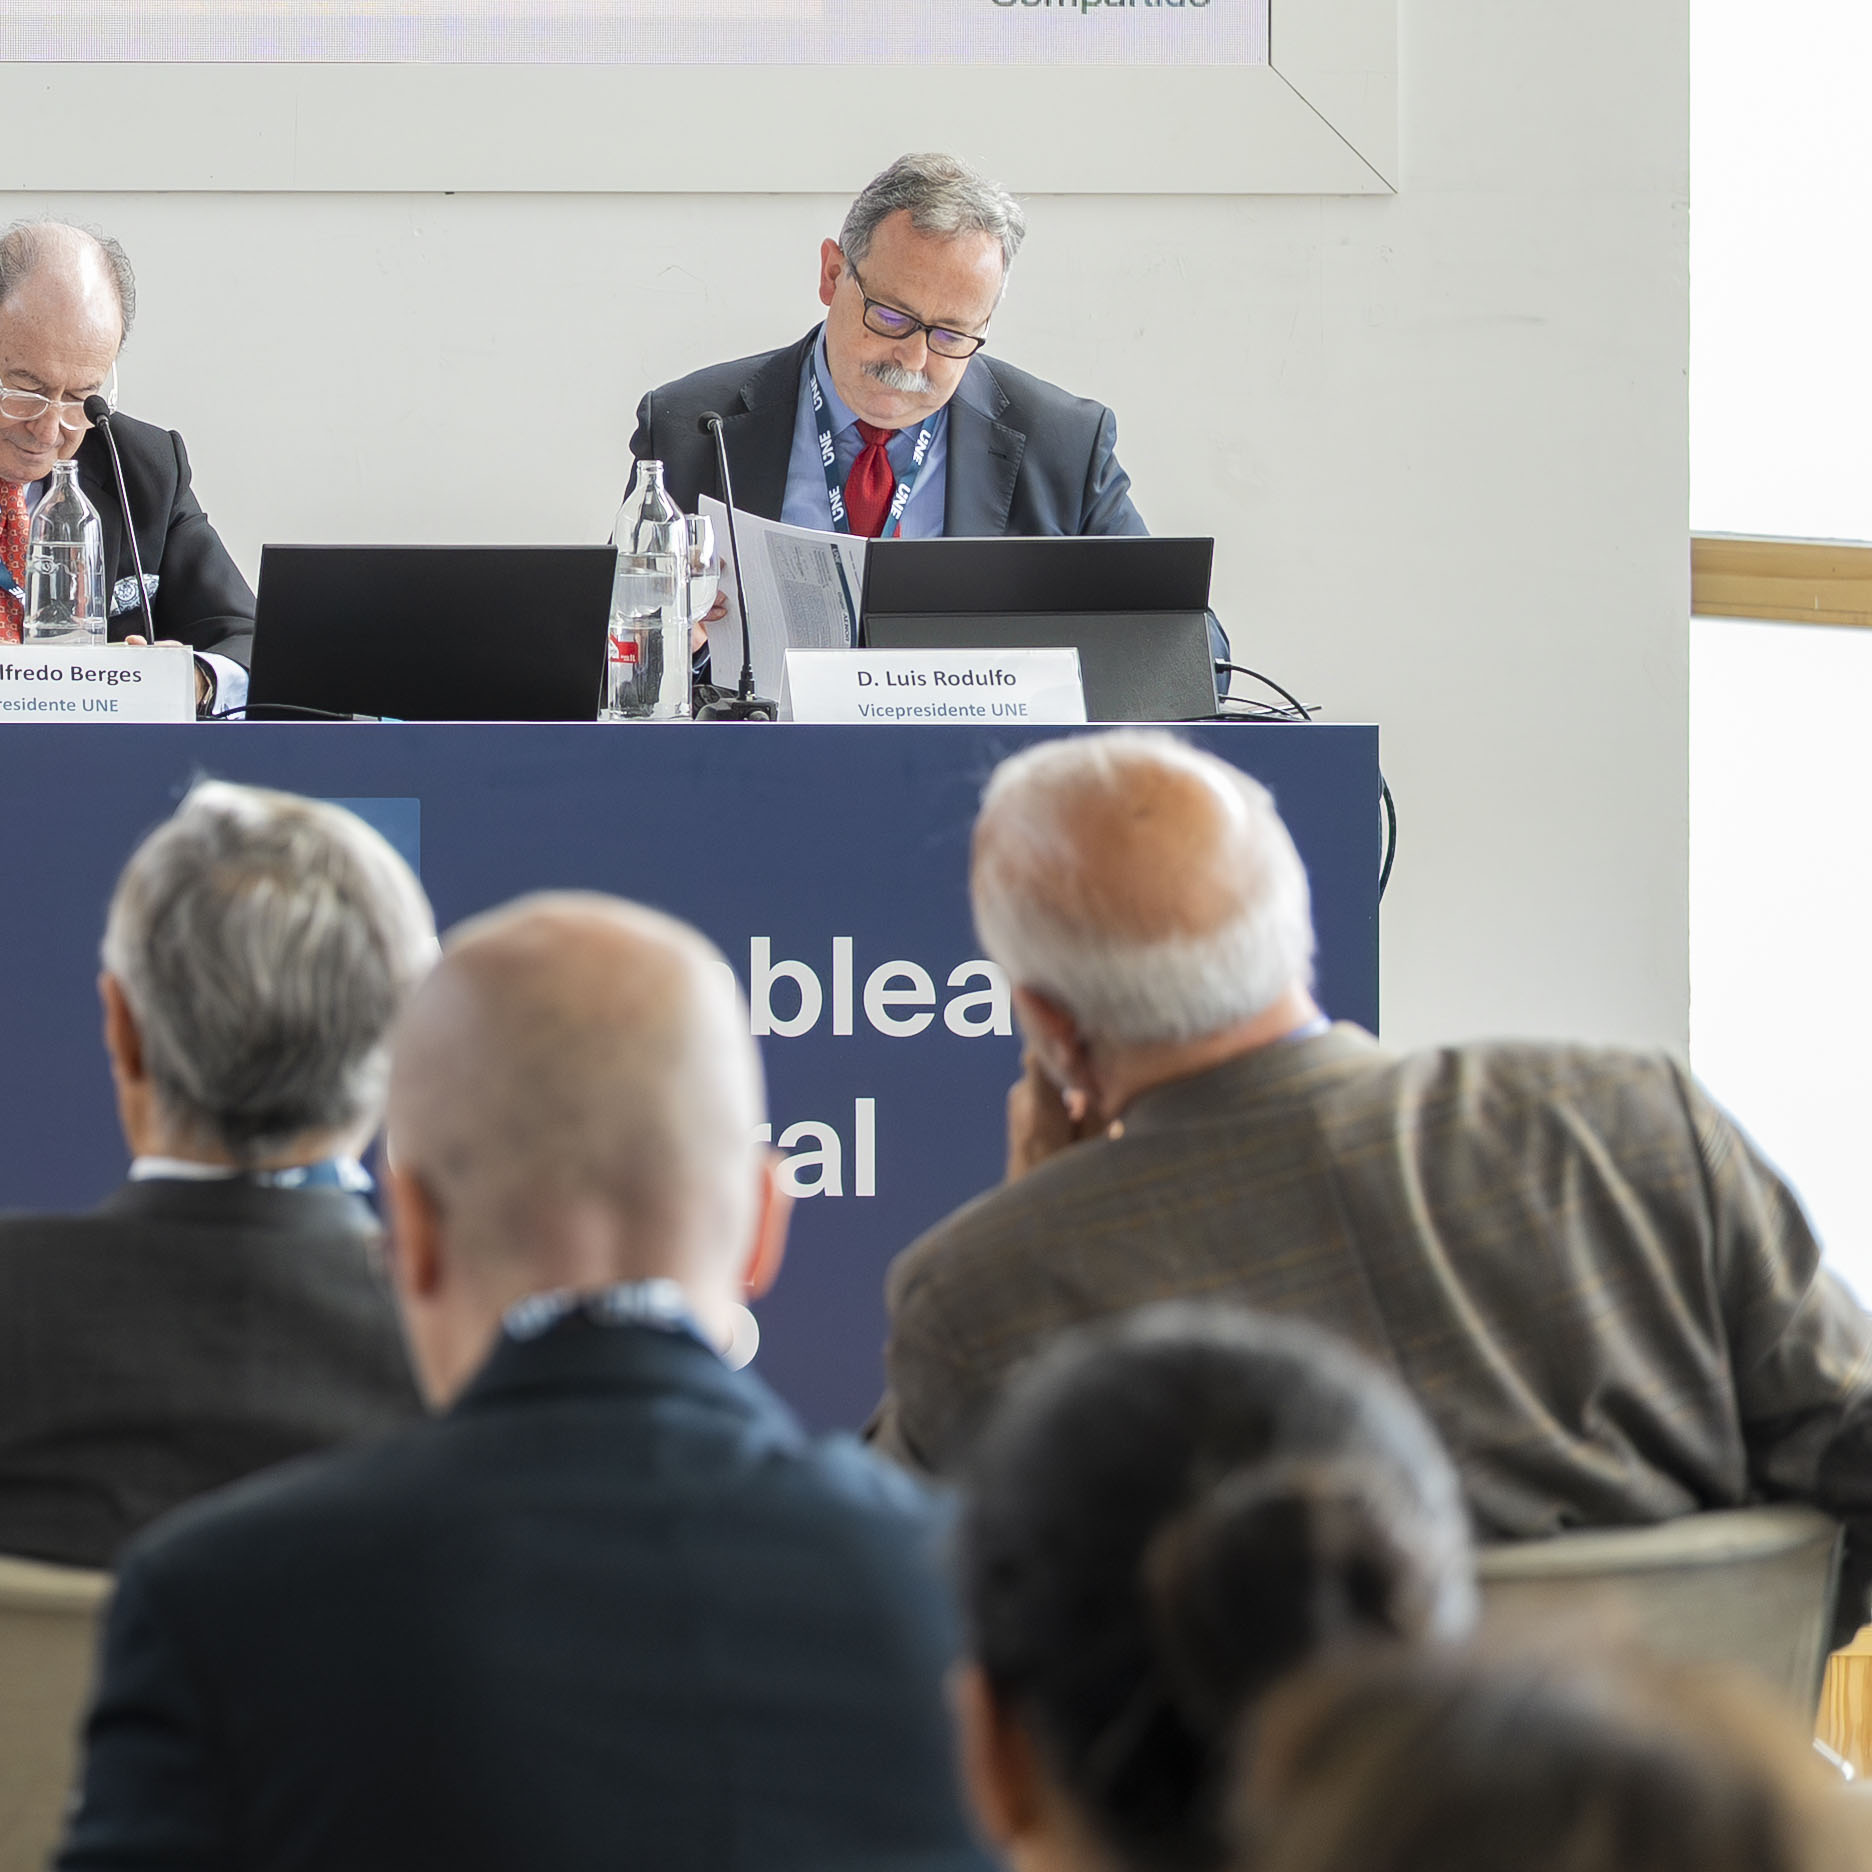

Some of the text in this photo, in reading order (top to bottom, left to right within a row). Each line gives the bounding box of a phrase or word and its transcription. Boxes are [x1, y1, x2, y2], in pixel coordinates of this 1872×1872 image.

[819, 430, 836, 467] UNE
[913, 429, 932, 466] UNE
[829, 485, 845, 522] UNE
[890, 483, 911, 520] UNE
[71, 667, 141, 685] Berges
[858, 670, 1015, 686] D. Luis Rodulfo
[83, 699, 118, 711] UNE
[859, 703, 1027, 719] Vicepresidente UNE
[740, 936, 1013, 1038] blea
